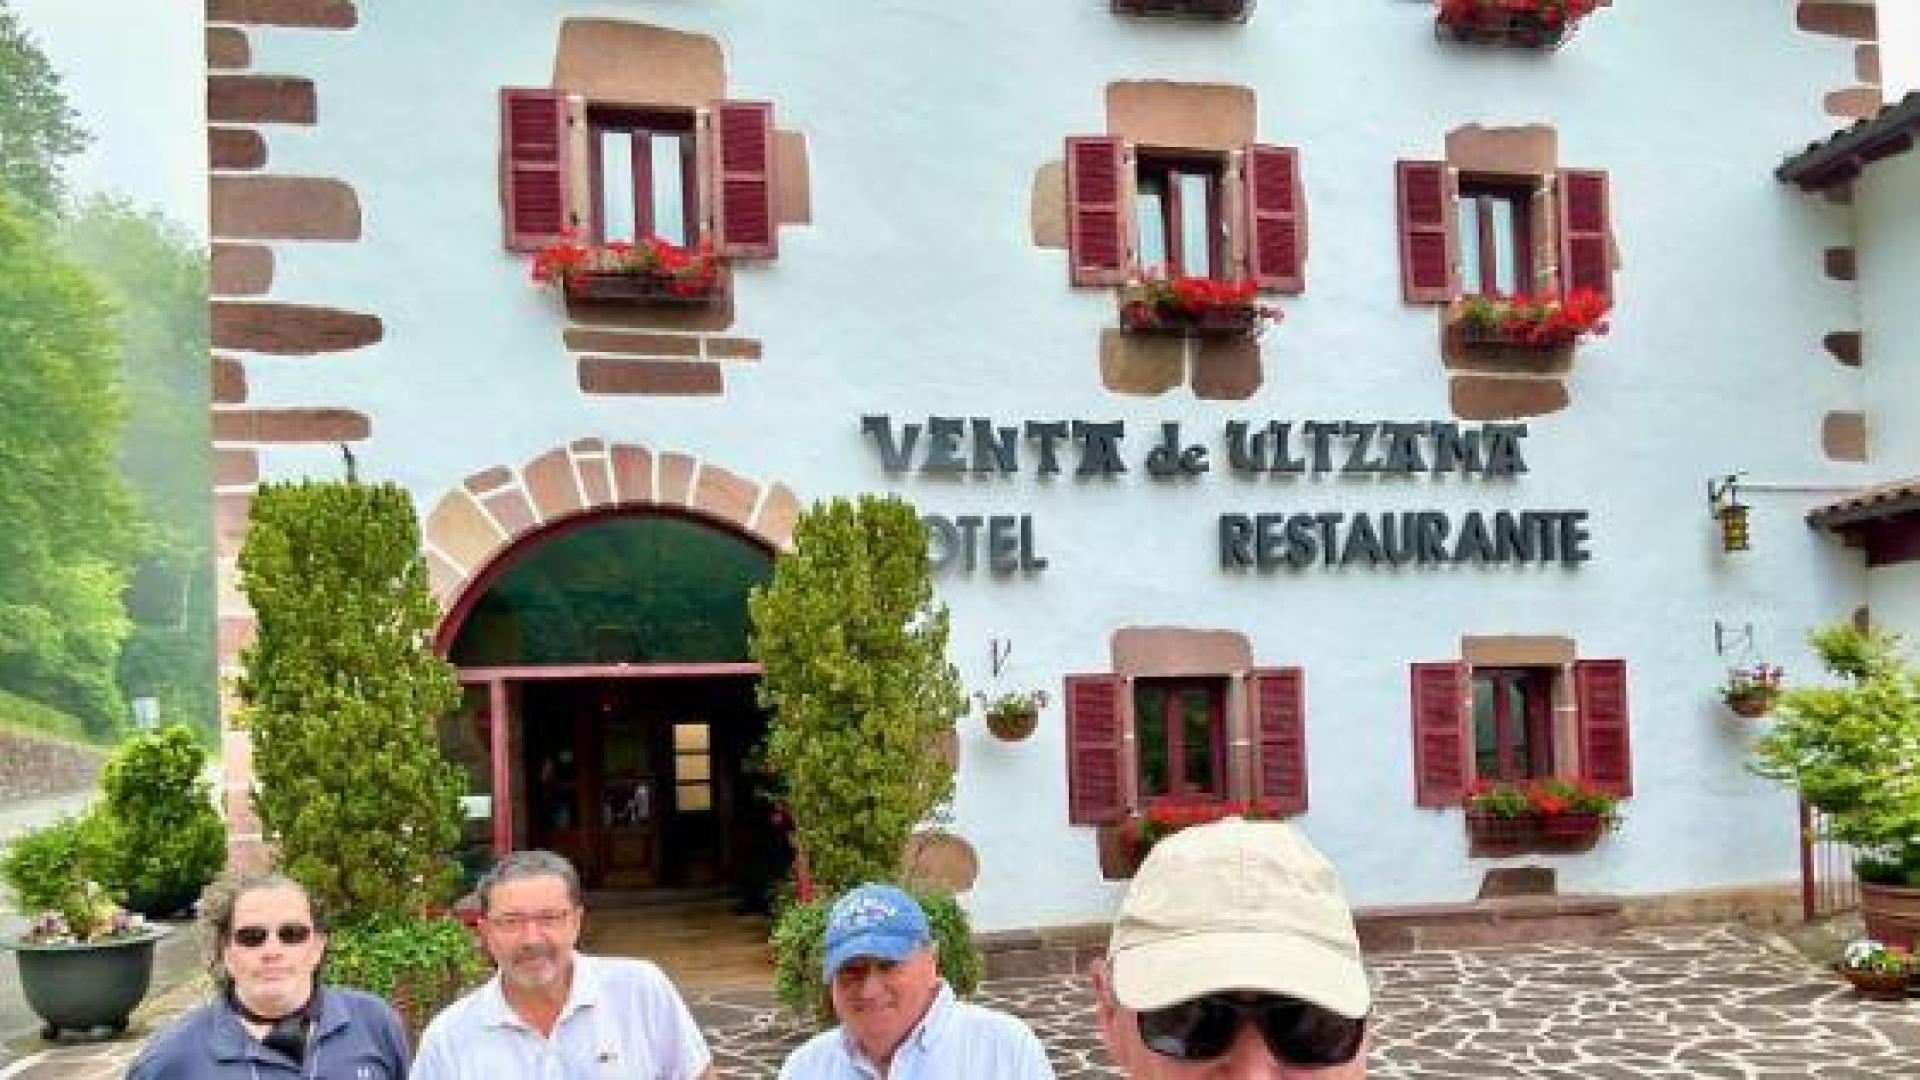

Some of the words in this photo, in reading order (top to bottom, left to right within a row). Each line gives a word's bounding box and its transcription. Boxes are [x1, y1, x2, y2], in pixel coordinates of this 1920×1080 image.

[861, 416, 1127, 474] VENTA
[1147, 421, 1210, 475] de
[1225, 420, 1530, 474] ULTZAMA
[921, 515, 1048, 572] OTEL
[1219, 510, 1592, 567] RESTAURANTE
